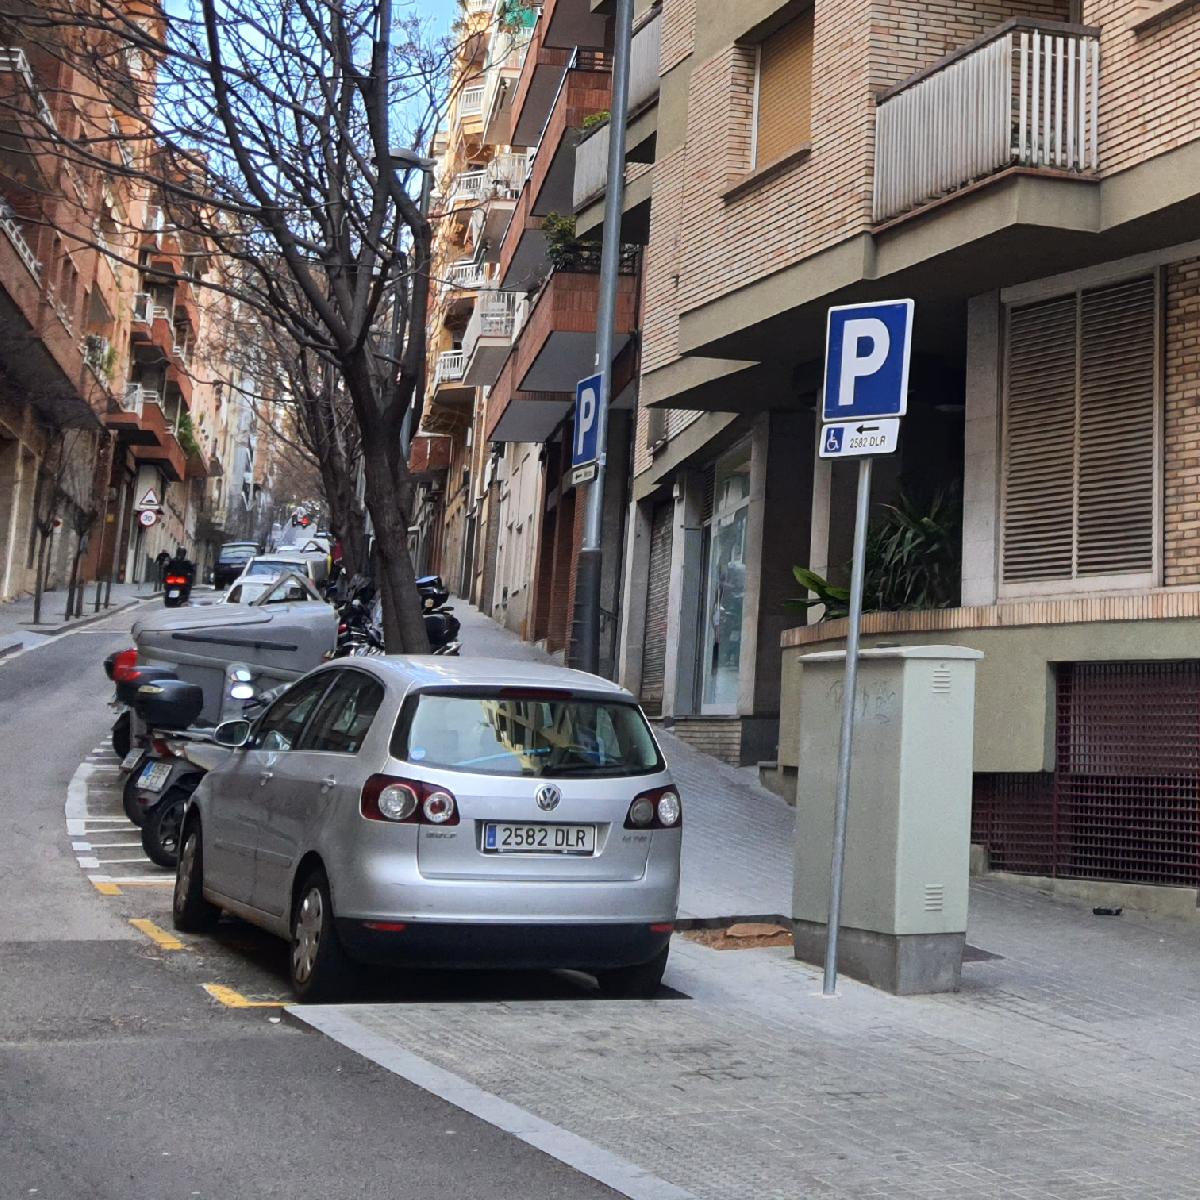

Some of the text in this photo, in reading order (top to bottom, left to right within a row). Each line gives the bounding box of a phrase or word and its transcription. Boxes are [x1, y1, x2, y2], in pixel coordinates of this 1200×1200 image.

[838, 318, 890, 406] P
[577, 387, 596, 456] P
[502, 827, 586, 848] 2582 DLR
